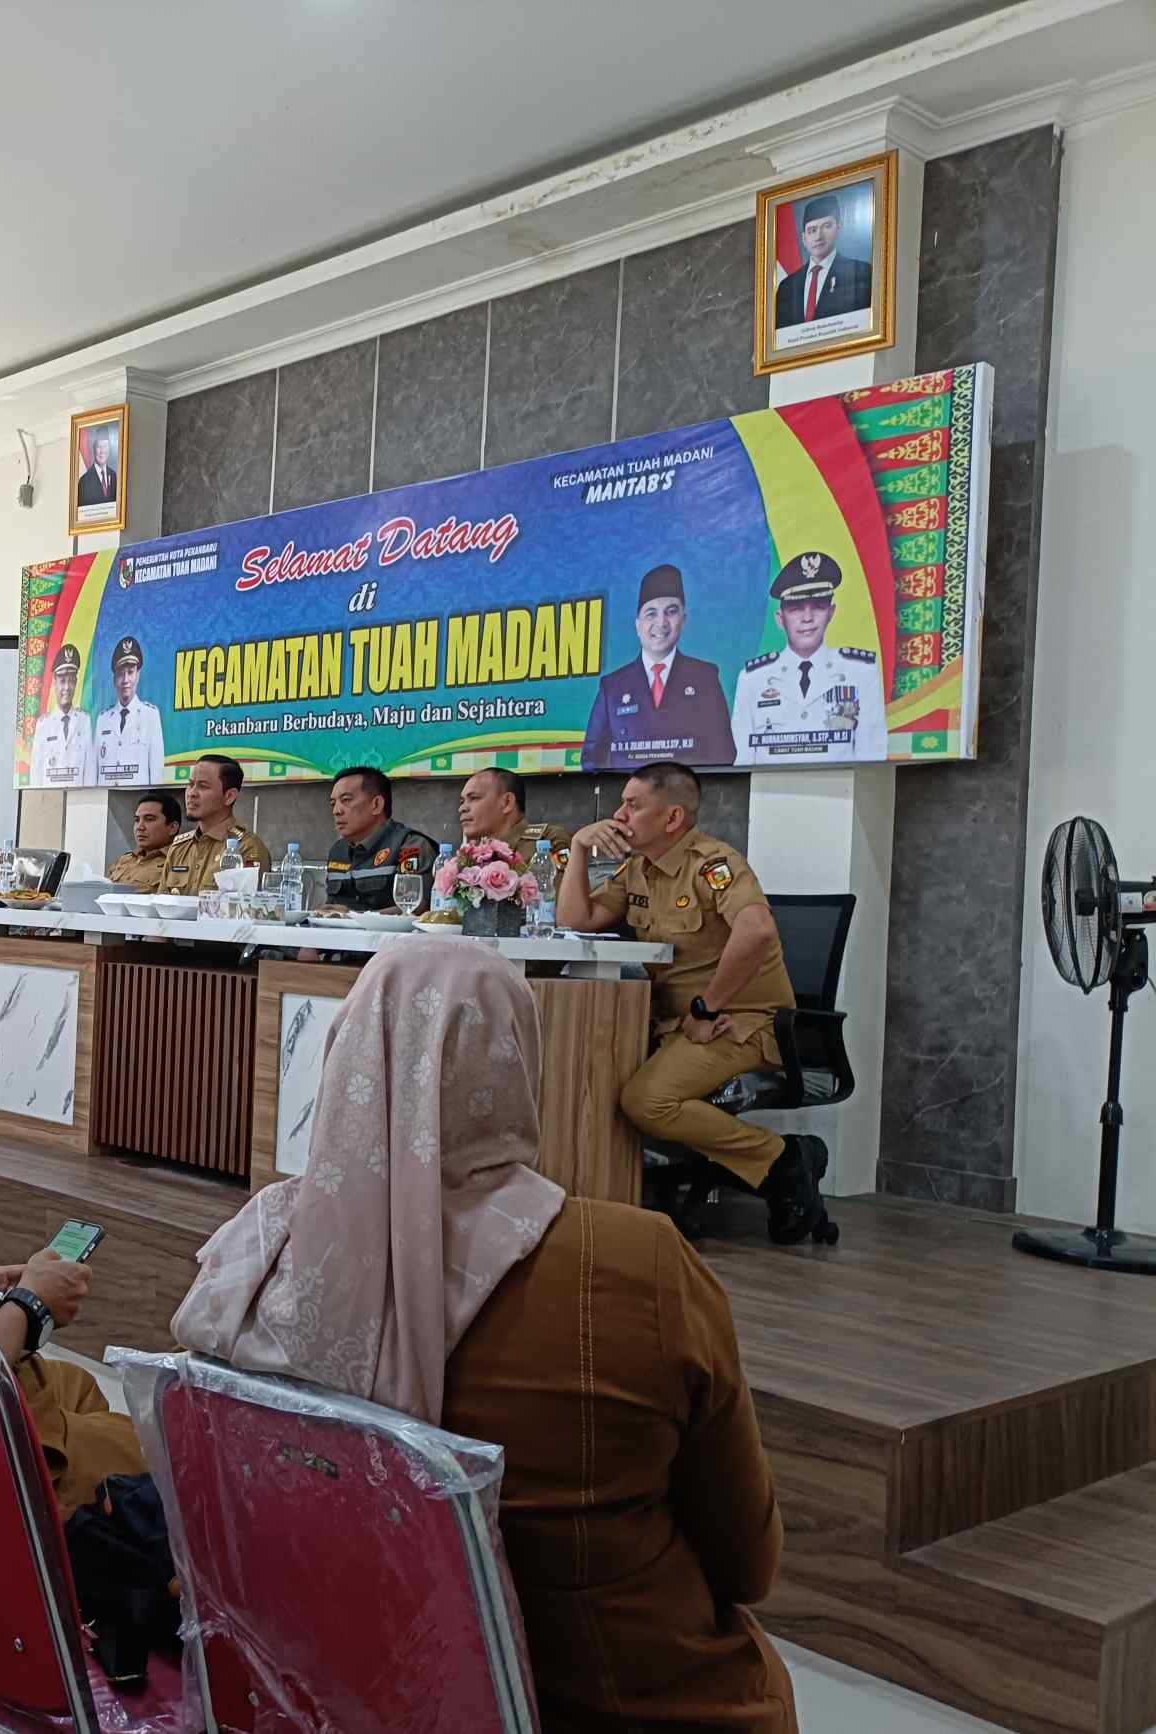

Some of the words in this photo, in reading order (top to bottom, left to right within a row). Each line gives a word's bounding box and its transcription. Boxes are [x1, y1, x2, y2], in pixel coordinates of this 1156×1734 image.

[554, 465, 624, 488] KECAMATAN
[627, 457, 660, 474] TUAH
[663, 446, 714, 467] MADANI
[585, 470, 675, 504] MANTAB'S
[134, 564, 172, 584] KECAMATAN
[172, 560, 190, 576] TUAH
[190, 555, 217, 573] MADANI
[235, 532, 371, 591] Selamat
[377, 514, 518, 562] Datang
[348, 582, 377, 612] di
[174, 632, 343, 710] KECAMATAN
[348, 619, 439, 695] TUAH
[445, 599, 604, 687] MADANI
[205, 714, 278, 736] Pekanbaru
[283, 709, 368, 736] Berbudaya,
[372, 704, 417, 728] Maju
[420, 704, 453, 722] dan
[457, 698, 545, 724] Sejahtera
